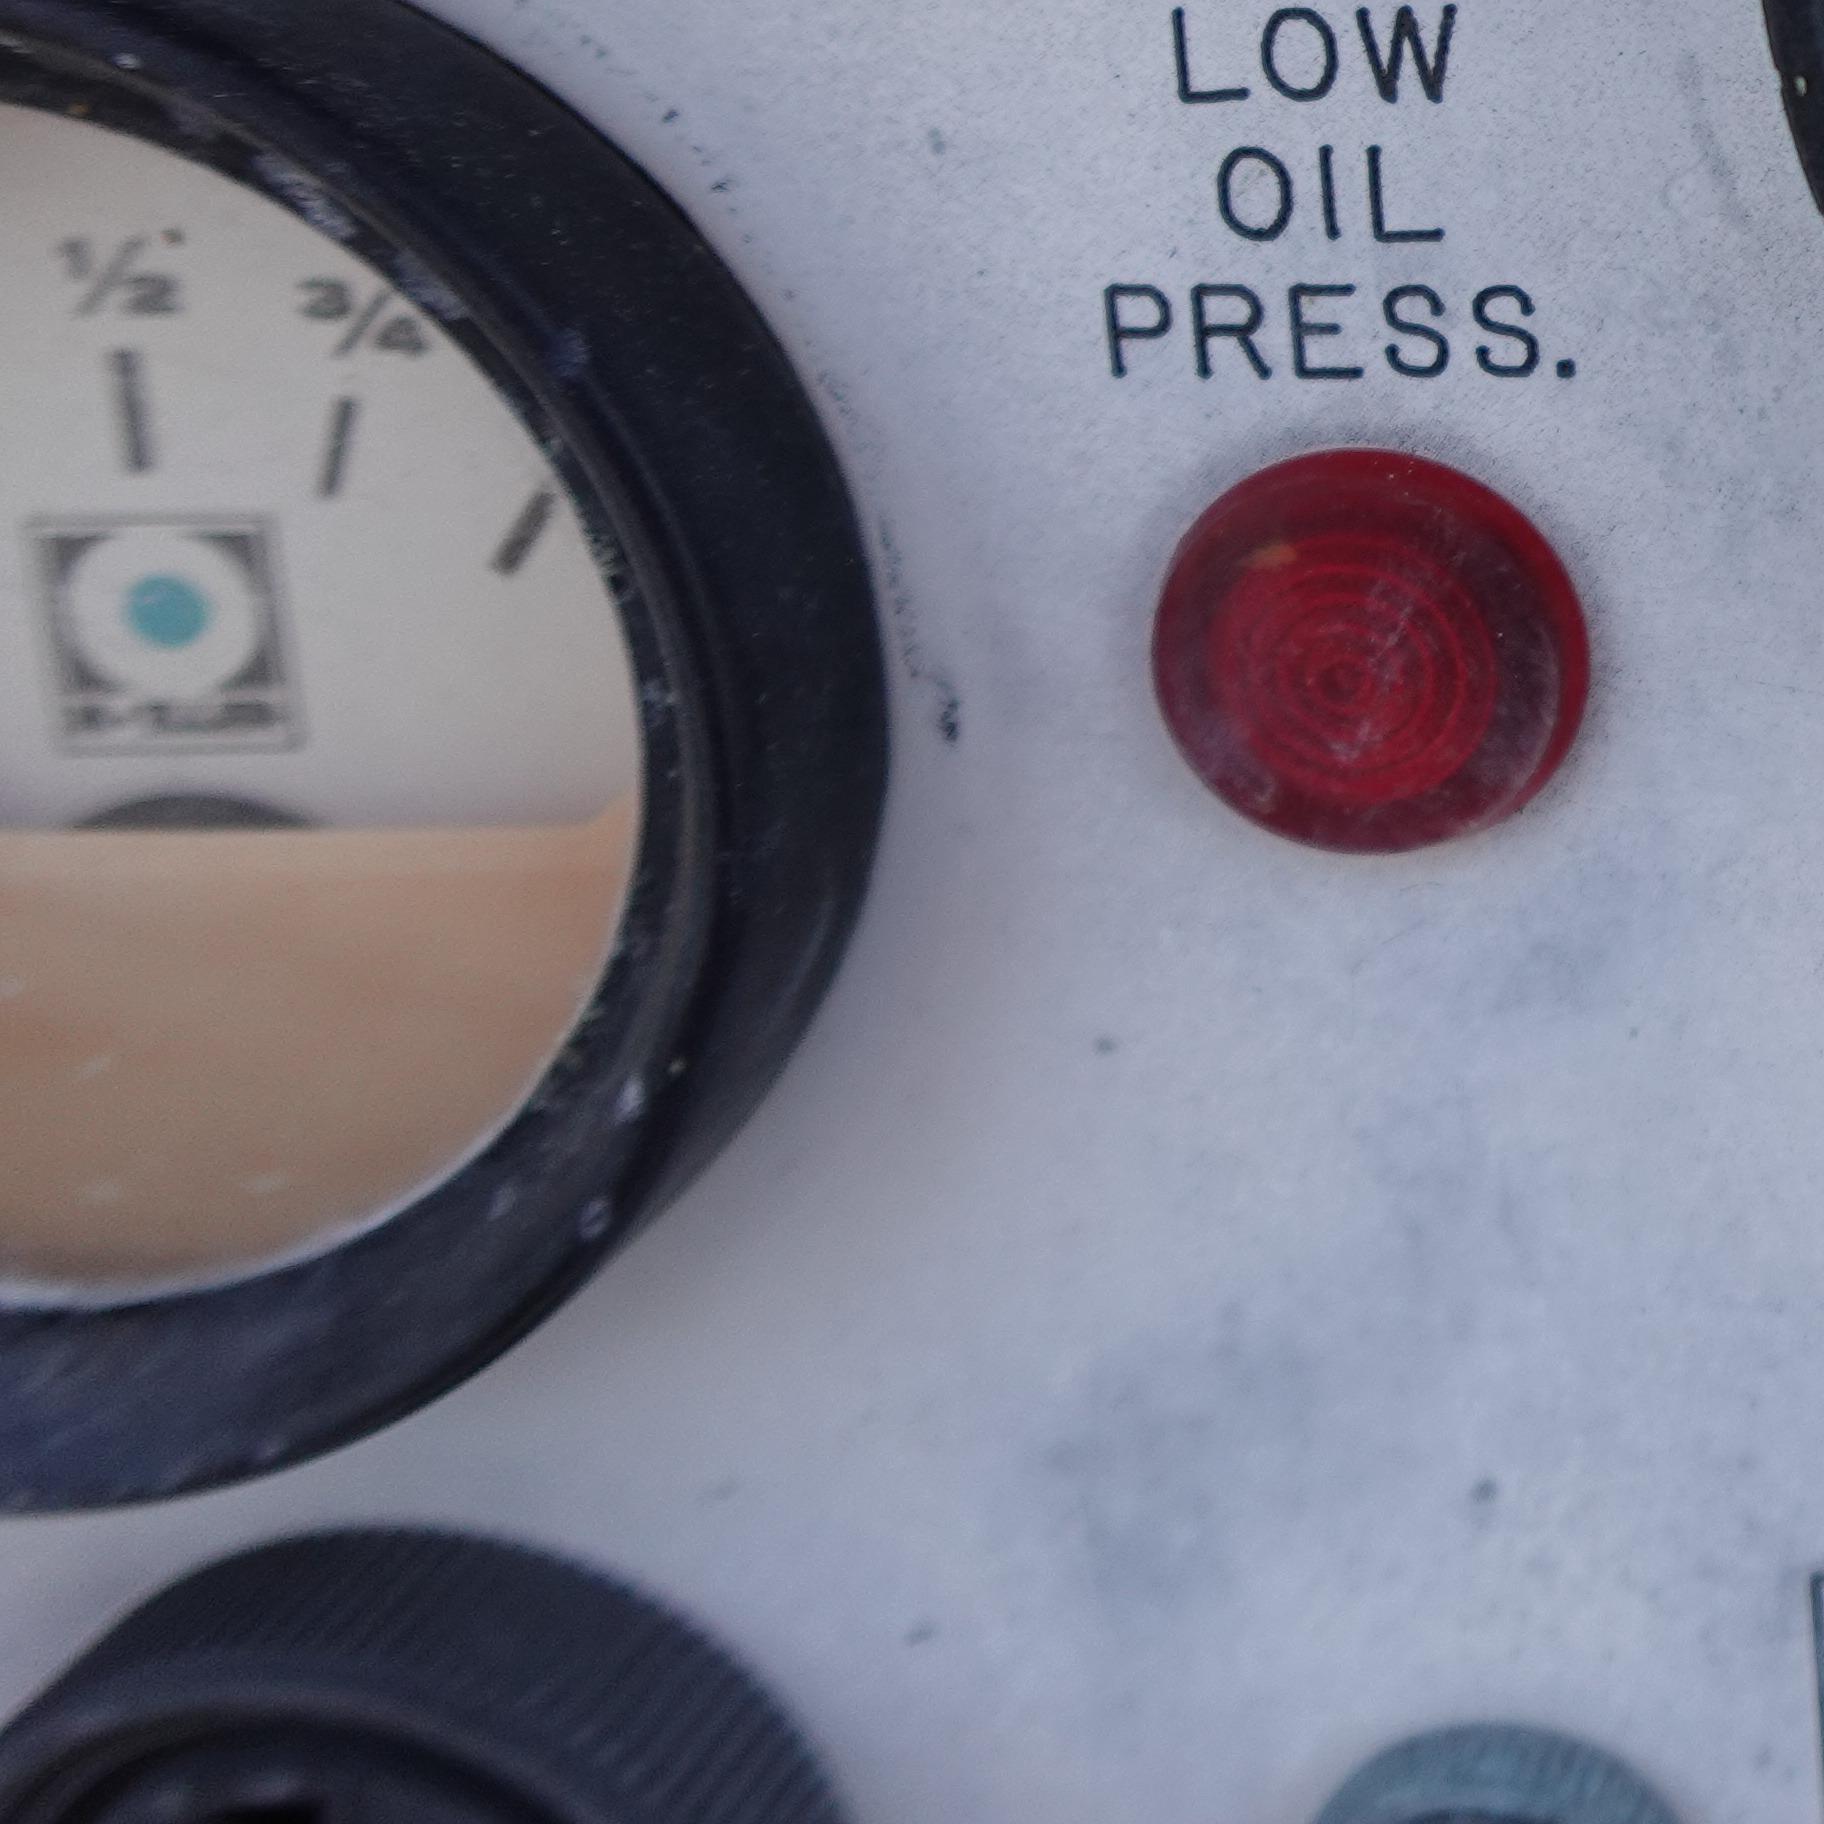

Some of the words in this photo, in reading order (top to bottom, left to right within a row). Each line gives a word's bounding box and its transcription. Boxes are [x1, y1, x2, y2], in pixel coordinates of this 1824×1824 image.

[1171, 4, 1457, 105] LOW
[1217, 144, 1445, 242] OIL
[1104, 283, 1576, 378] PRESS.
